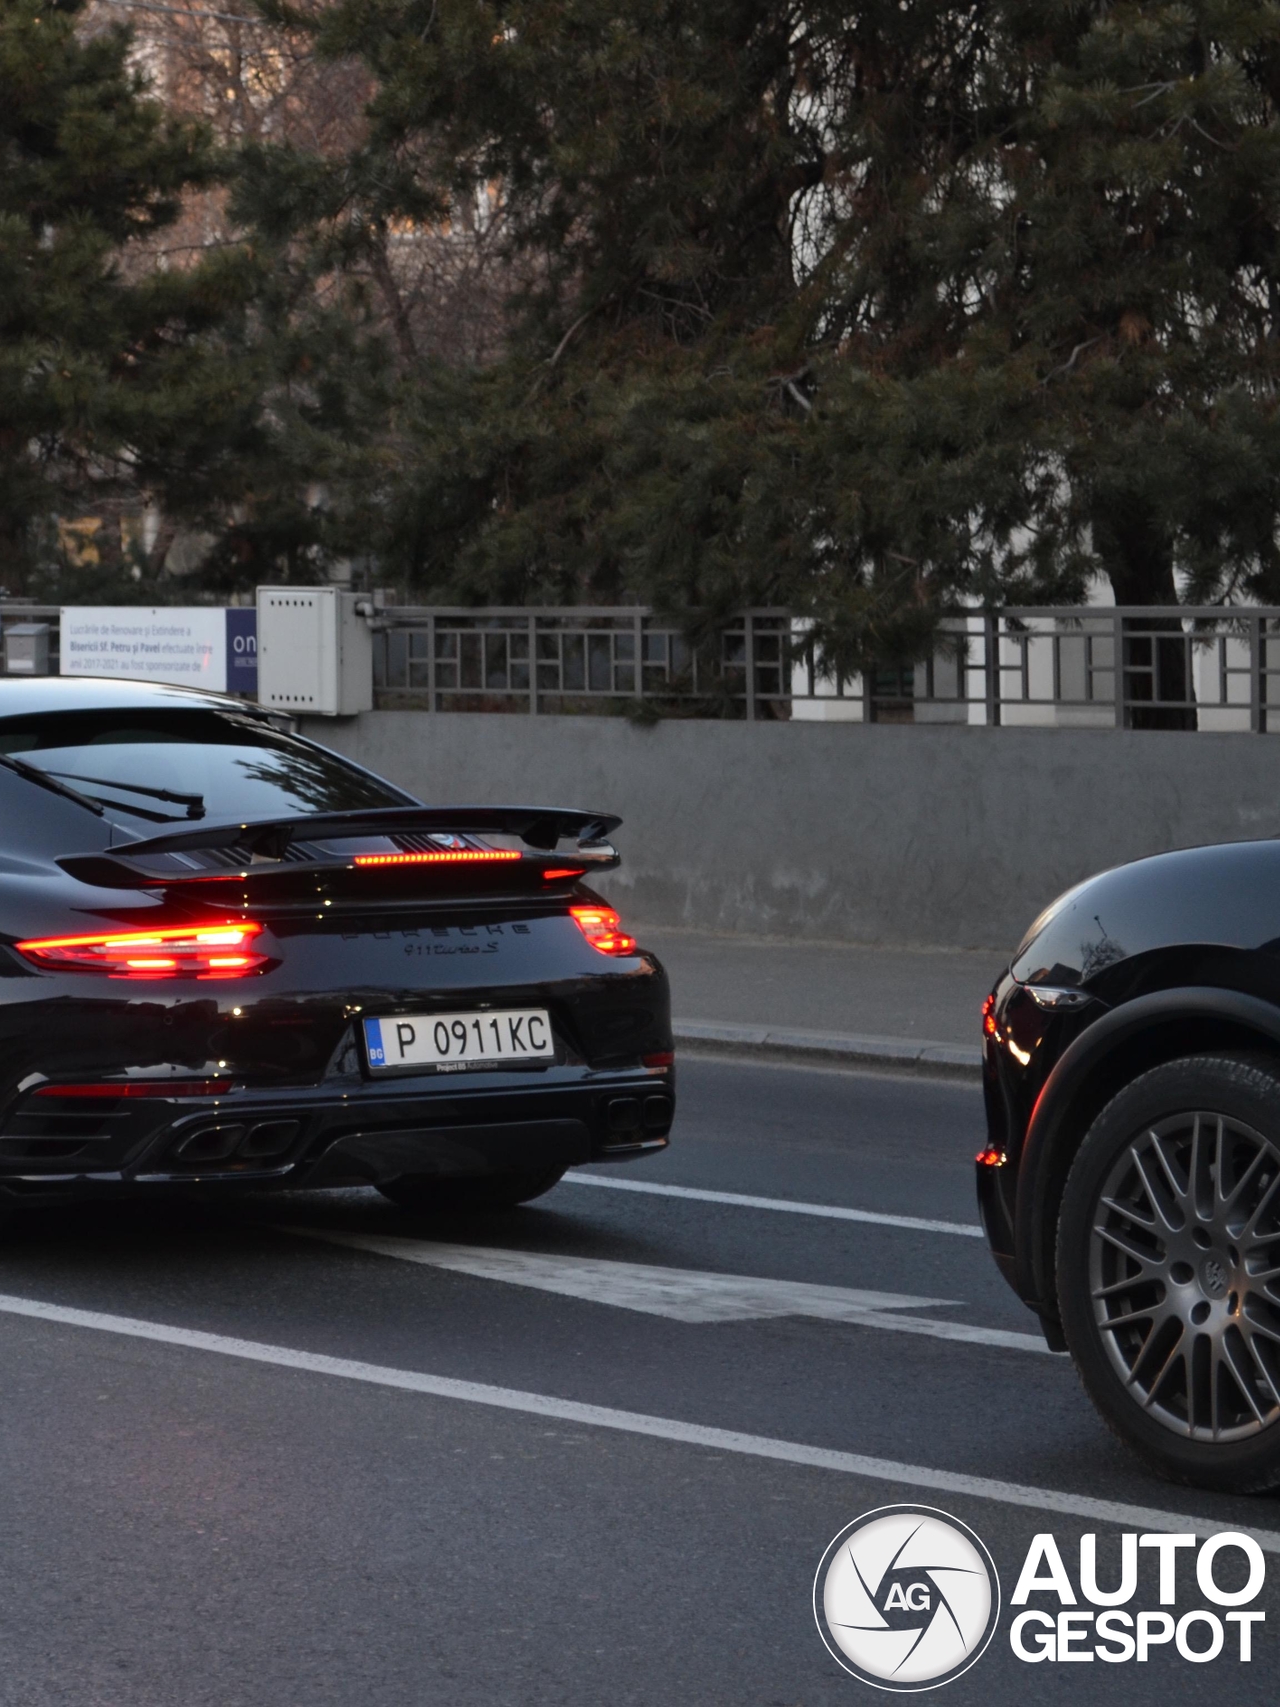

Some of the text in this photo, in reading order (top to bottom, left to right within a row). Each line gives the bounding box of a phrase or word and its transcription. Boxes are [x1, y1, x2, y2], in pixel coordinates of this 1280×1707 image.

[100, 625, 109, 635] de
[110, 625, 143, 635] Renovare
[152, 625, 185, 636] Extindere
[70, 641, 98, 652] Bisericii
[111, 642, 131, 652] Petru
[140, 642, 160, 653] Pavel
[162, 643, 195, 654] efectuate
[84, 659, 118, 670] 2017-2021
[131, 660, 144, 670] fost
[145, 661, 190, 672] sponsorizate
[192, 661, 202, 672] de
[370, 1048, 383, 1060] BG
[436, 1063, 457, 1072] Project
